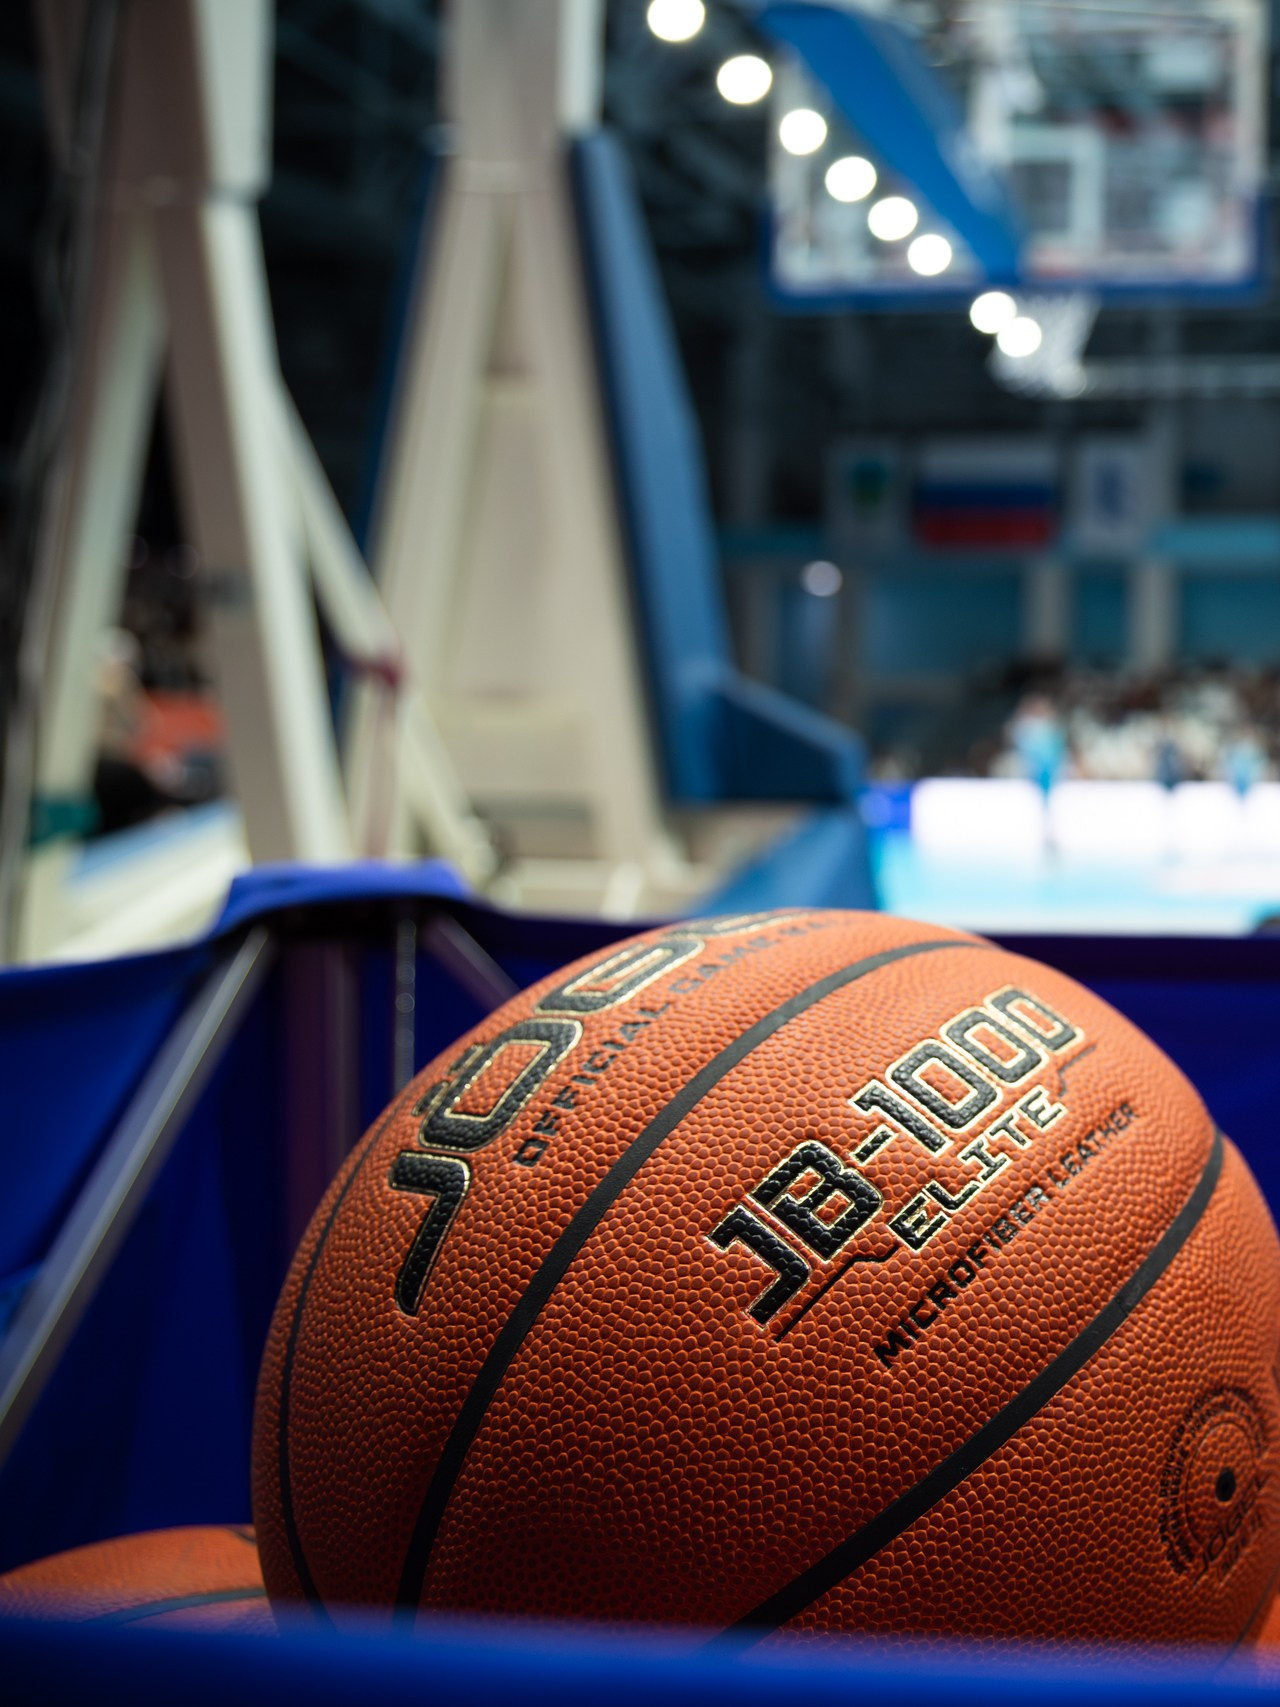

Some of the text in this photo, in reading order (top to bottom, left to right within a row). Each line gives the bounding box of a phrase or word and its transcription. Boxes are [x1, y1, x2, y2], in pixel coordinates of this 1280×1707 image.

[512, 1000, 672, 1168] OFFICIAL
[704, 983, 1086, 1332] JB-1000
[886, 1084, 1068, 1253] ELITE
[872, 1100, 1141, 1370] MICROFIBER LEATHER
